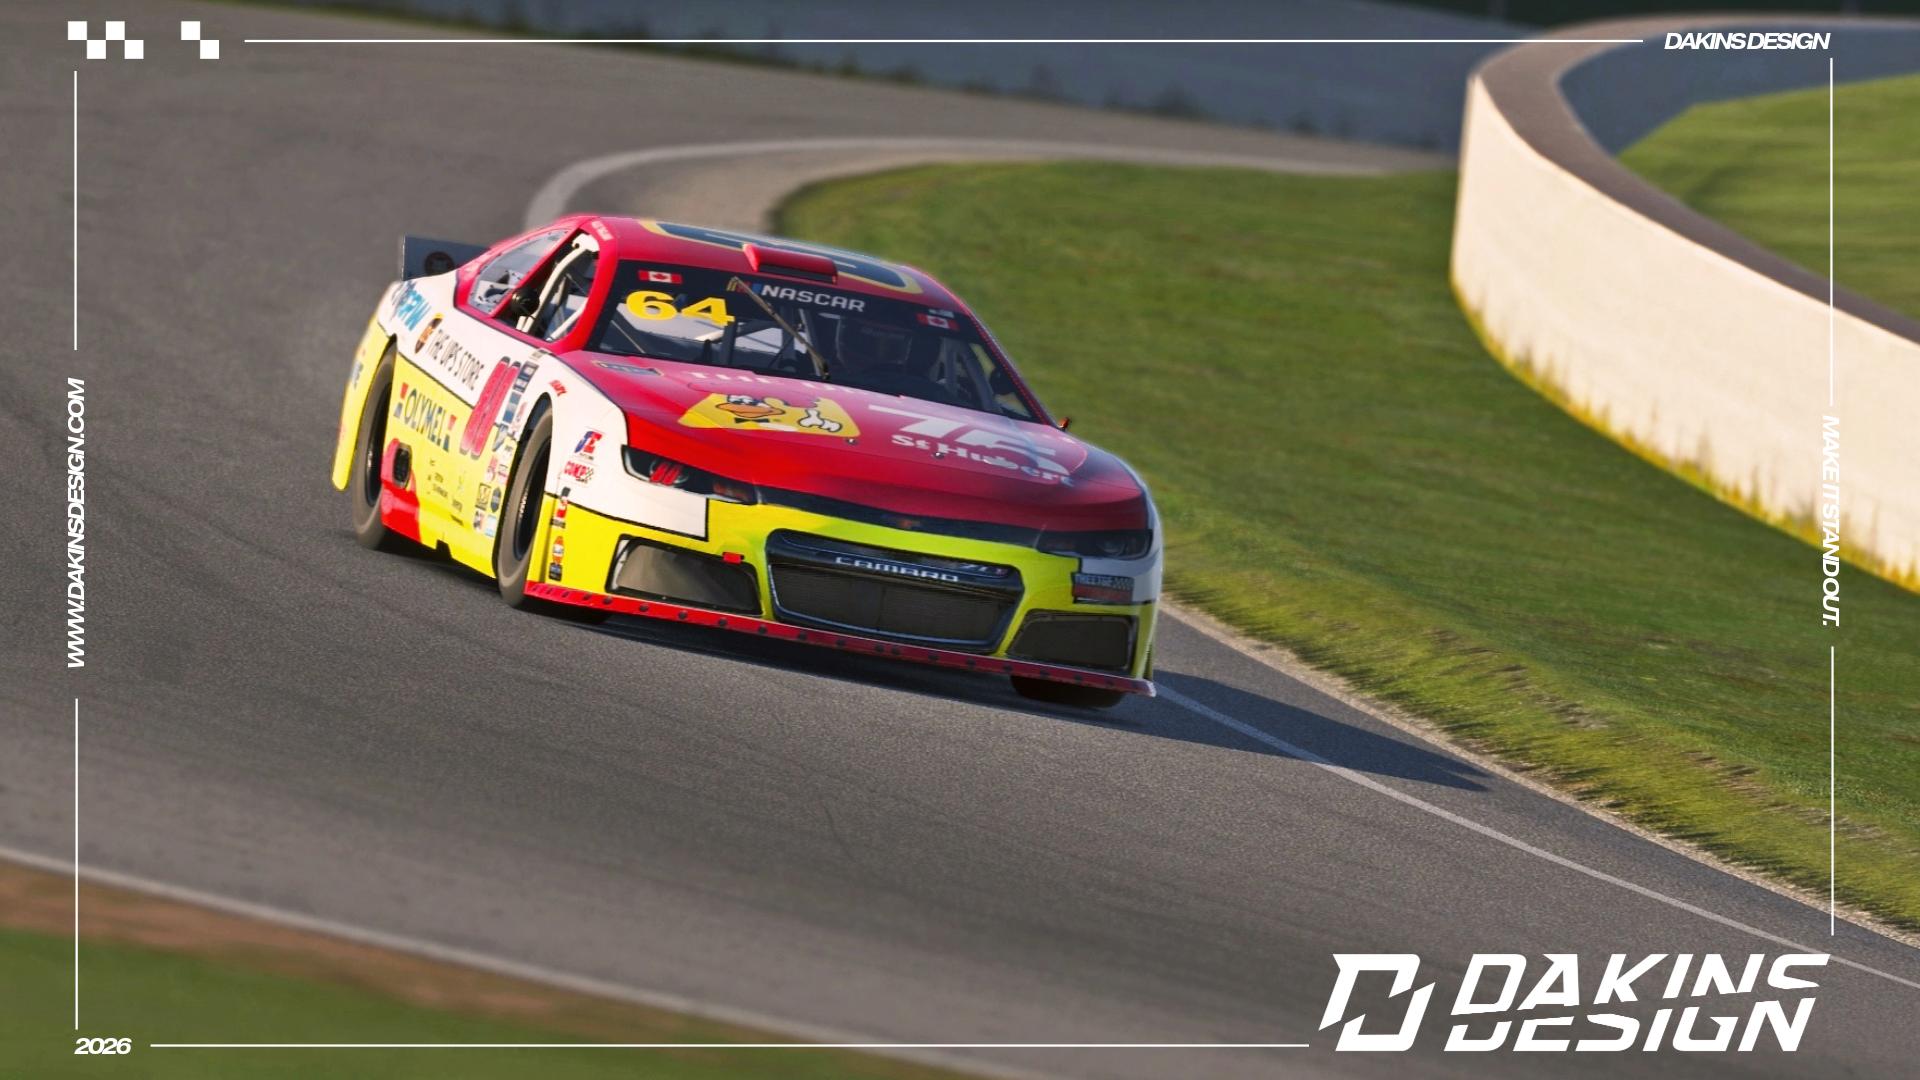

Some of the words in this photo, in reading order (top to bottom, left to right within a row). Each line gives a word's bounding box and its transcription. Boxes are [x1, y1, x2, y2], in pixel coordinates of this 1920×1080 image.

[626, 290, 736, 326] 64
[761, 284, 866, 312] NASCAR
[453, 351, 485, 391] STORE
[404, 388, 447, 447] OLYMEL
[835, 556, 959, 583] CAMARO
